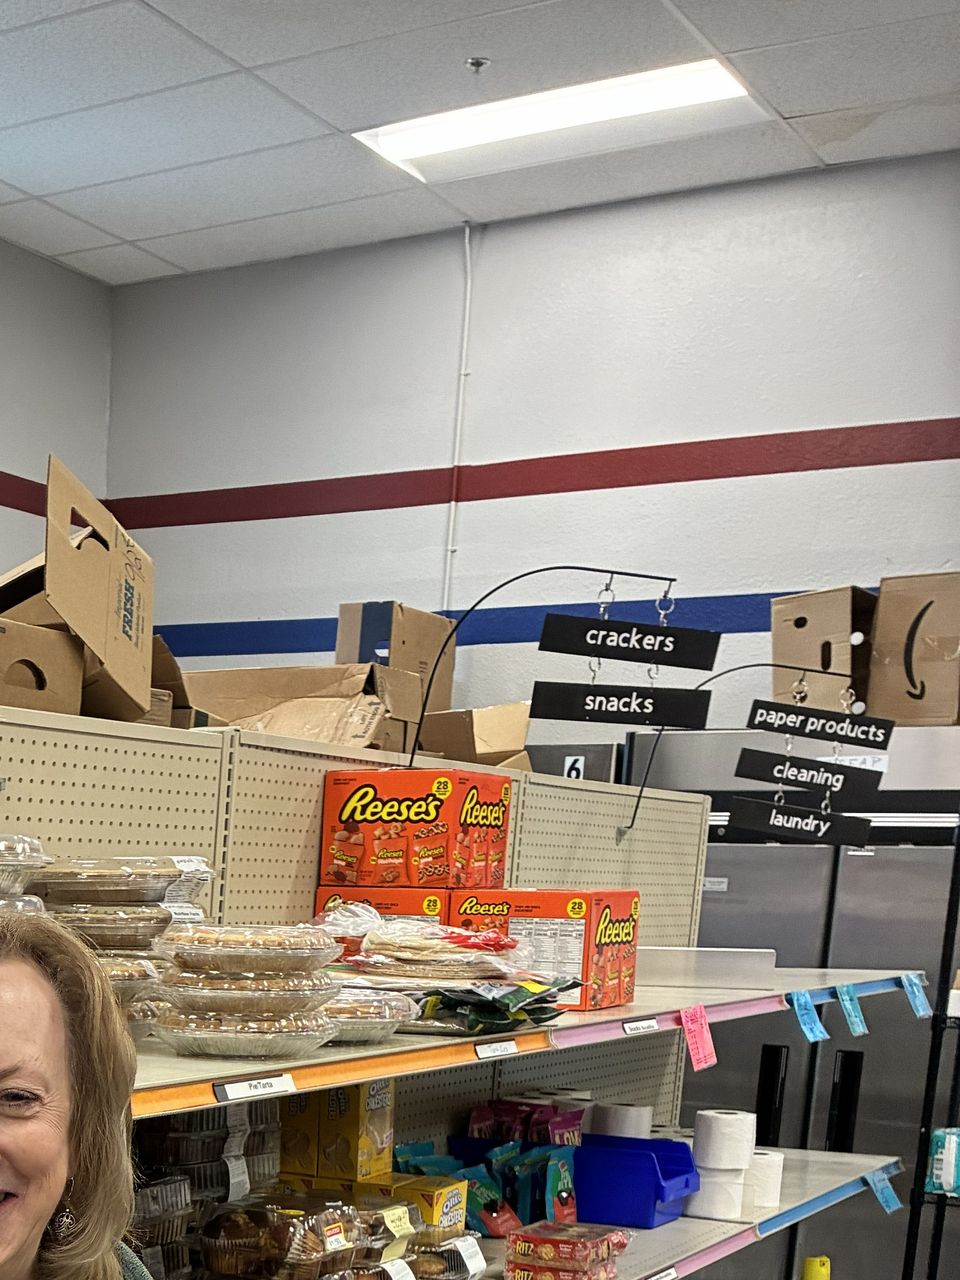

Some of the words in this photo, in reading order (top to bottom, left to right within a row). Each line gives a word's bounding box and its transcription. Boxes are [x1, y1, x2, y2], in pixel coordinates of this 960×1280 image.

[586, 627, 675, 652] crackers
[584, 691, 654, 713] snacks
[754, 708, 805, 728] paper
[805, 717, 886, 742] products
[566, 758, 581, 779] 6
[772, 761, 845, 792] cleaning
[437, 781, 448, 790] 28
[340, 784, 443, 824] Reese's
[460, 785, 506, 828] Reese's
[769, 808, 831, 837] laundry
[426, 899, 438, 908] 28
[459, 896, 512, 916] Reese's
[571, 901, 583, 910] 28
[595, 906, 636, 947] Reese's
[442, 1194, 462, 1213] OREO
[515, 1241, 534, 1255] RITZ
